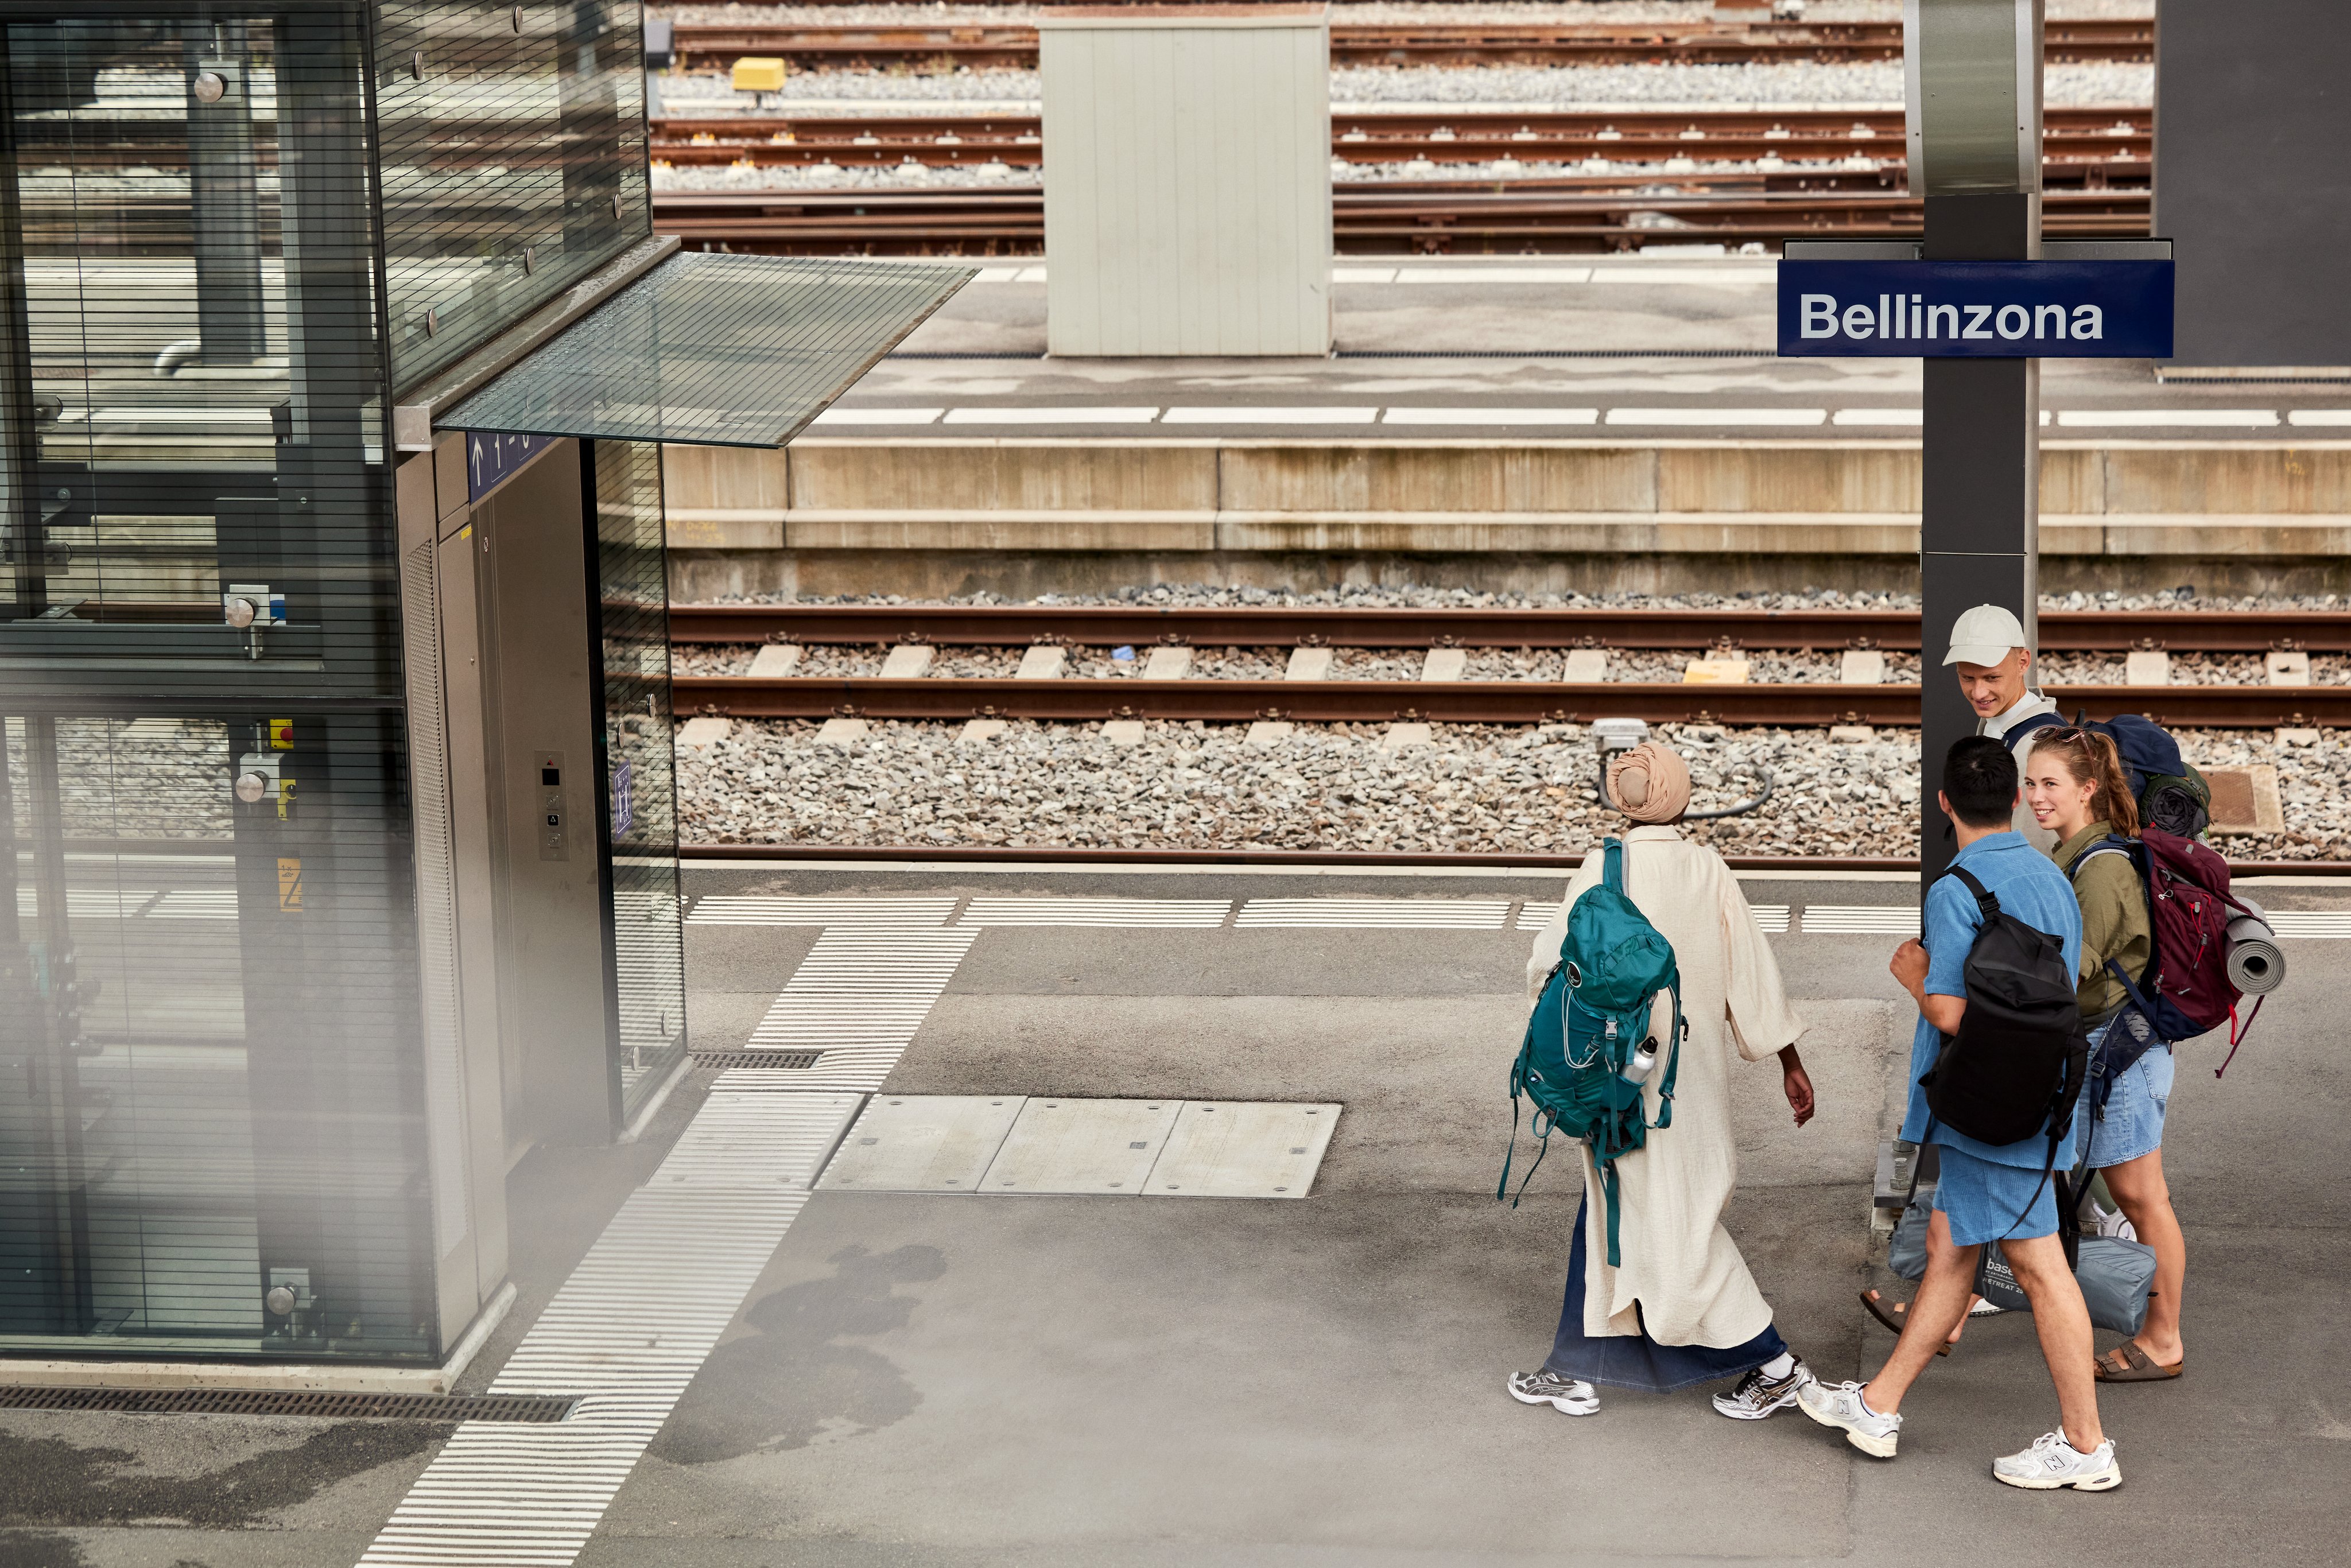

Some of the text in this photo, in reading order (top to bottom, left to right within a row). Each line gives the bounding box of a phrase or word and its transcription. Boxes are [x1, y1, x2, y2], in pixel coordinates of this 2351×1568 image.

[1801, 294, 2103, 340] Bellinzona
[1987, 1257, 2014, 1276] base
[1983, 1277, 2015, 1291] RETREAT
[1837, 1399, 1850, 1415] N
[2043, 1455, 2065, 1472] N
